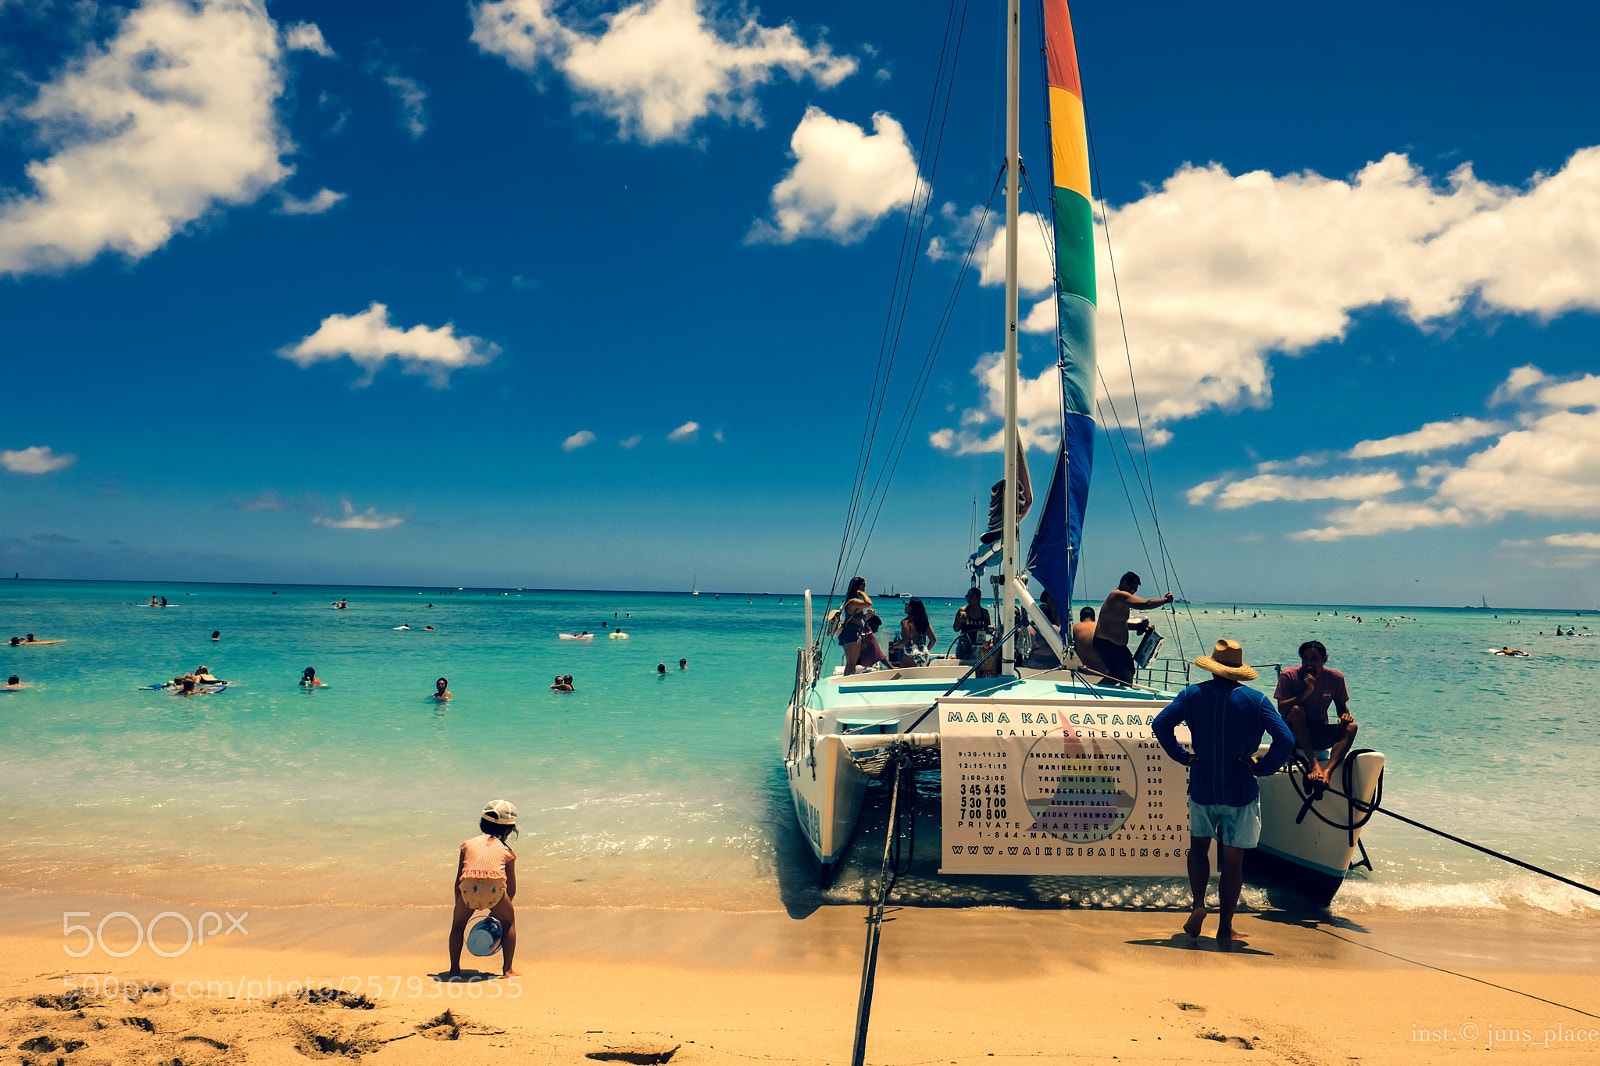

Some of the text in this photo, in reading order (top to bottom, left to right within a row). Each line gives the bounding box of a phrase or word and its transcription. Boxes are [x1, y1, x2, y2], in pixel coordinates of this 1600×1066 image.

[948, 712, 1156, 726] MANA KAI CATAMA
[996, 729, 1048, 737] DAILY
[958, 821, 1190, 832] PRIVATE CHARTERS AVAILABL
[952, 845, 1192, 858] WWW.WAIKIKISAILING.CO
